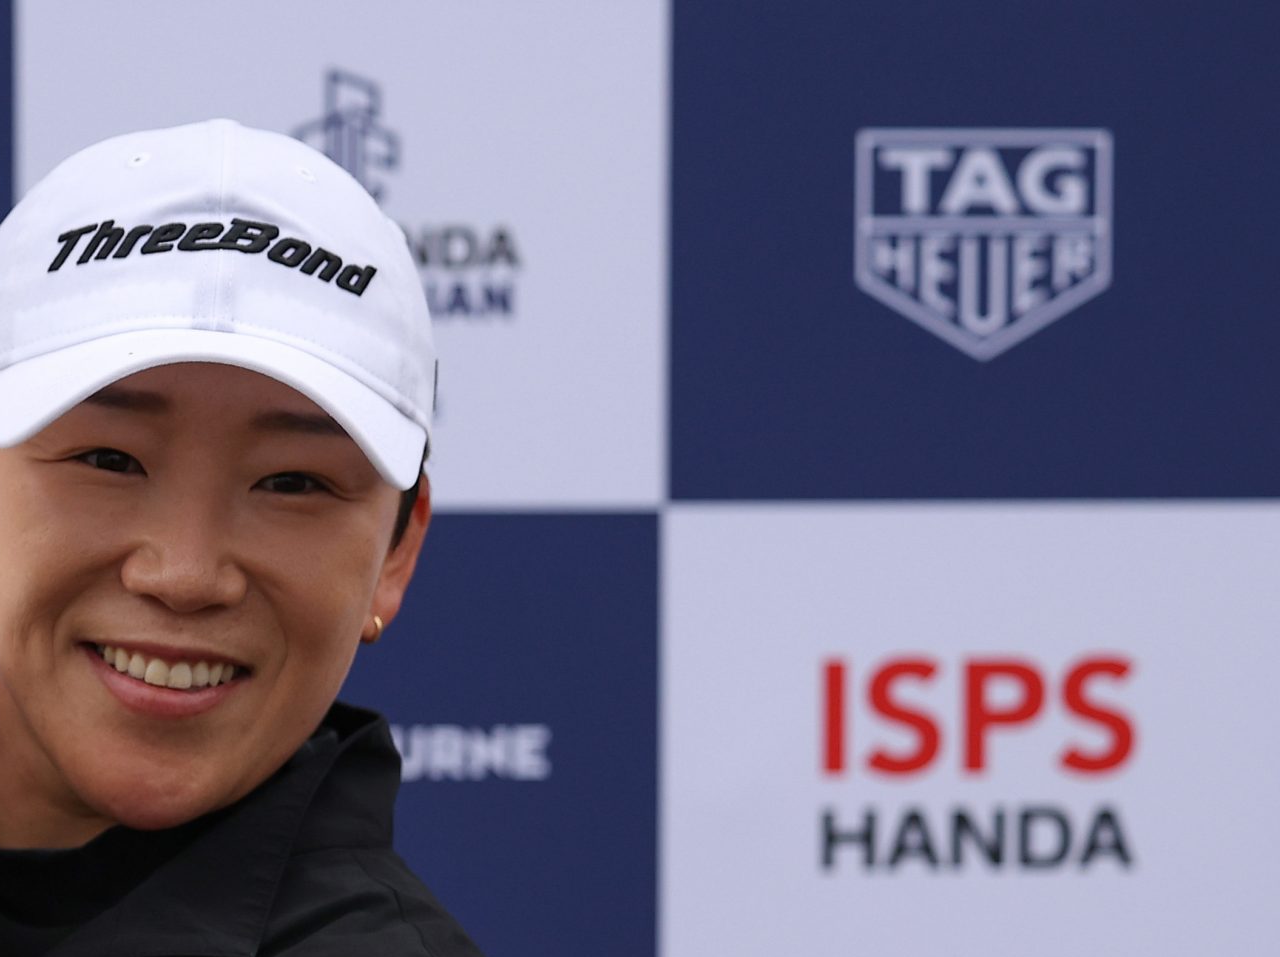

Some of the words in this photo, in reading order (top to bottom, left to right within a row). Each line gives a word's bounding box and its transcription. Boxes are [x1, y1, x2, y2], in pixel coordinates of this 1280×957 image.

[878, 147, 1088, 216] TAG
[47, 218, 377, 297] ThreeBond
[871, 233, 1094, 335] HEUER
[823, 655, 1137, 777] ISPS
[821, 807, 1134, 870] HANDA
